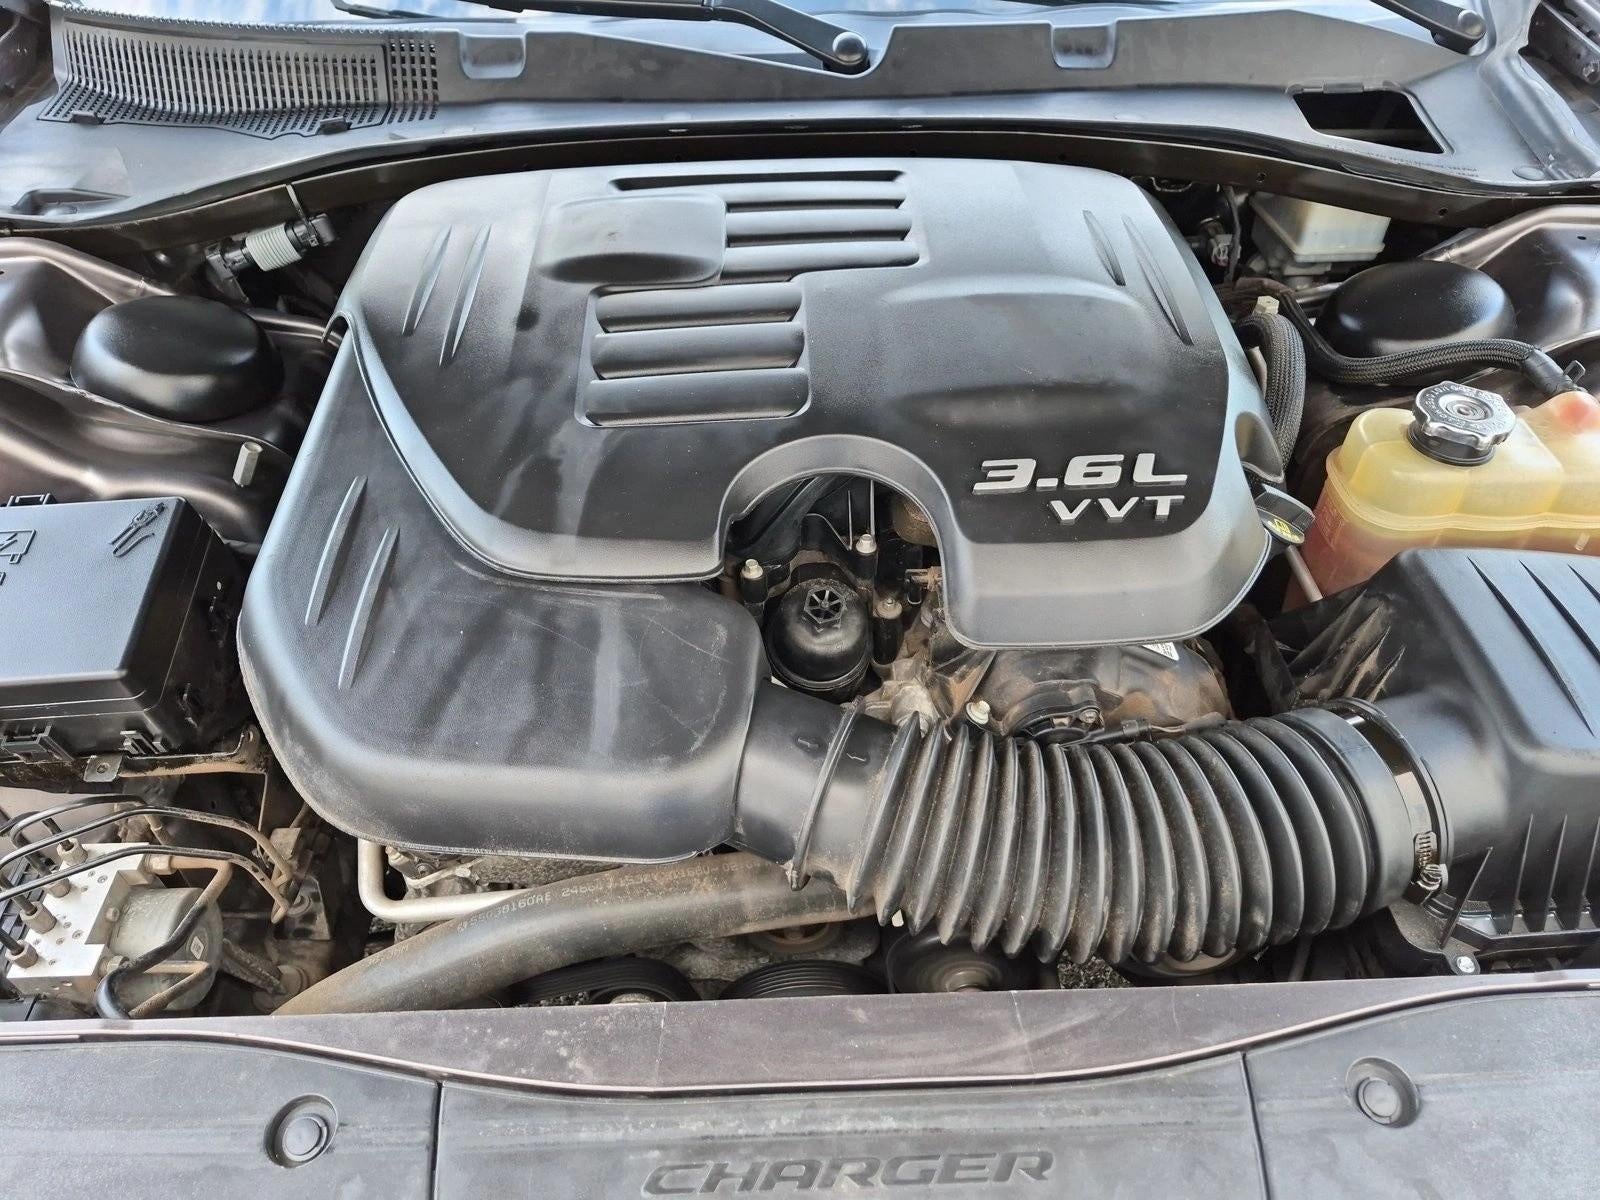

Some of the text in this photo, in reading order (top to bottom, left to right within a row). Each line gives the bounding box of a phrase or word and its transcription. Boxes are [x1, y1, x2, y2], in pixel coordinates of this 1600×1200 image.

[972, 453, 1188, 494] 3.6L
[1051, 495, 1185, 525] VVT
[641, 1150, 1055, 1197] CHARGER
